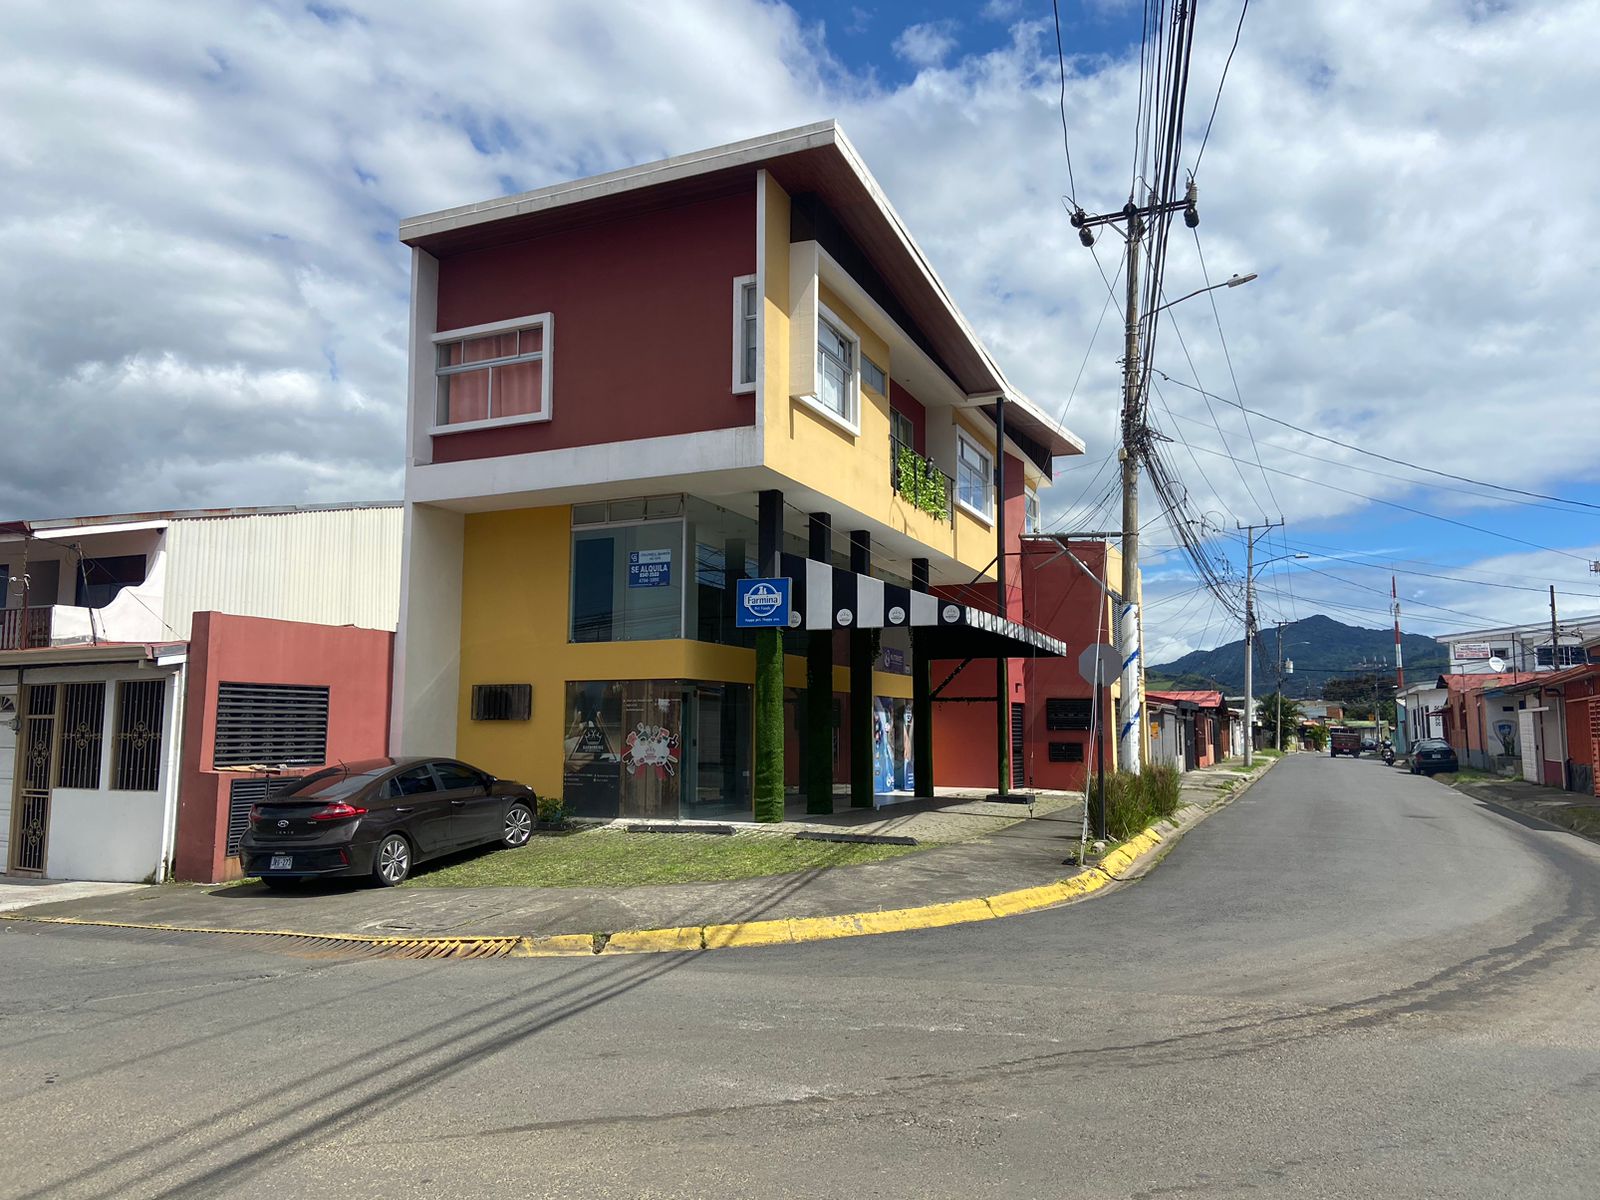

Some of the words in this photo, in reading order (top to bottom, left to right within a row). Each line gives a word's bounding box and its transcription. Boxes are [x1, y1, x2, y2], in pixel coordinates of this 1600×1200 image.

[631, 566, 640, 574] SE
[640, 564, 668, 572] ALQUILA
[748, 596, 778, 604] Farmina
